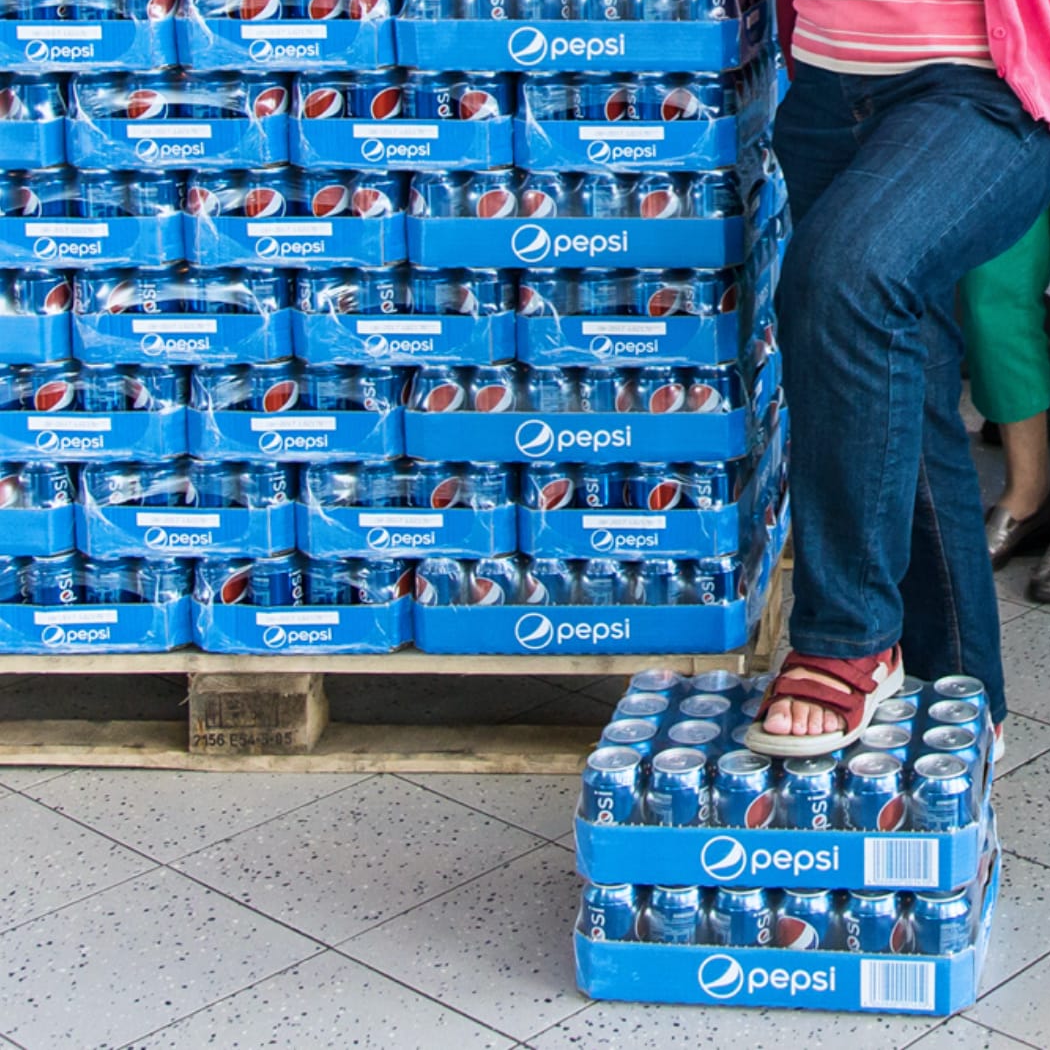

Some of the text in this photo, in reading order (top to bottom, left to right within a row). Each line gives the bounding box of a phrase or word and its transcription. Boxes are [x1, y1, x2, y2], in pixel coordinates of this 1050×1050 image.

[50, 43, 94, 59] pepsi
[273, 43, 319, 58] pepsi
[551, 34, 625, 60] pepsi
[160, 142, 205, 158] pepsi
[387, 143, 430, 158] pepsi
[612, 144, 657, 159] pepsi
[58, 241, 101, 256] pepsi
[281, 240, 324, 255] pepsi
[554, 231, 628, 256] pepsi
[164, 337, 209, 352] pepsi
[389, 338, 433, 353] pepsi
[614, 339, 658, 354] pepsi
[60, 435, 103, 450] pepsi
[284, 435, 328, 450] pepsi
[557, 426, 632, 452] pepsi
[170, 532, 213, 547] pepsi
[391, 532, 435, 547] pepsi
[615, 533, 659, 549] pepsi
[67, 627, 110, 643] pepsi
[287, 626, 332, 642] pepsi
[557, 619, 630, 644] pepsi
[593, 790, 618, 827] psi
[808, 789, 831, 831] psi
[751, 846, 839, 875] pepsi
[588, 905, 607, 943] psi
[748, 967, 836, 995] pepsi
